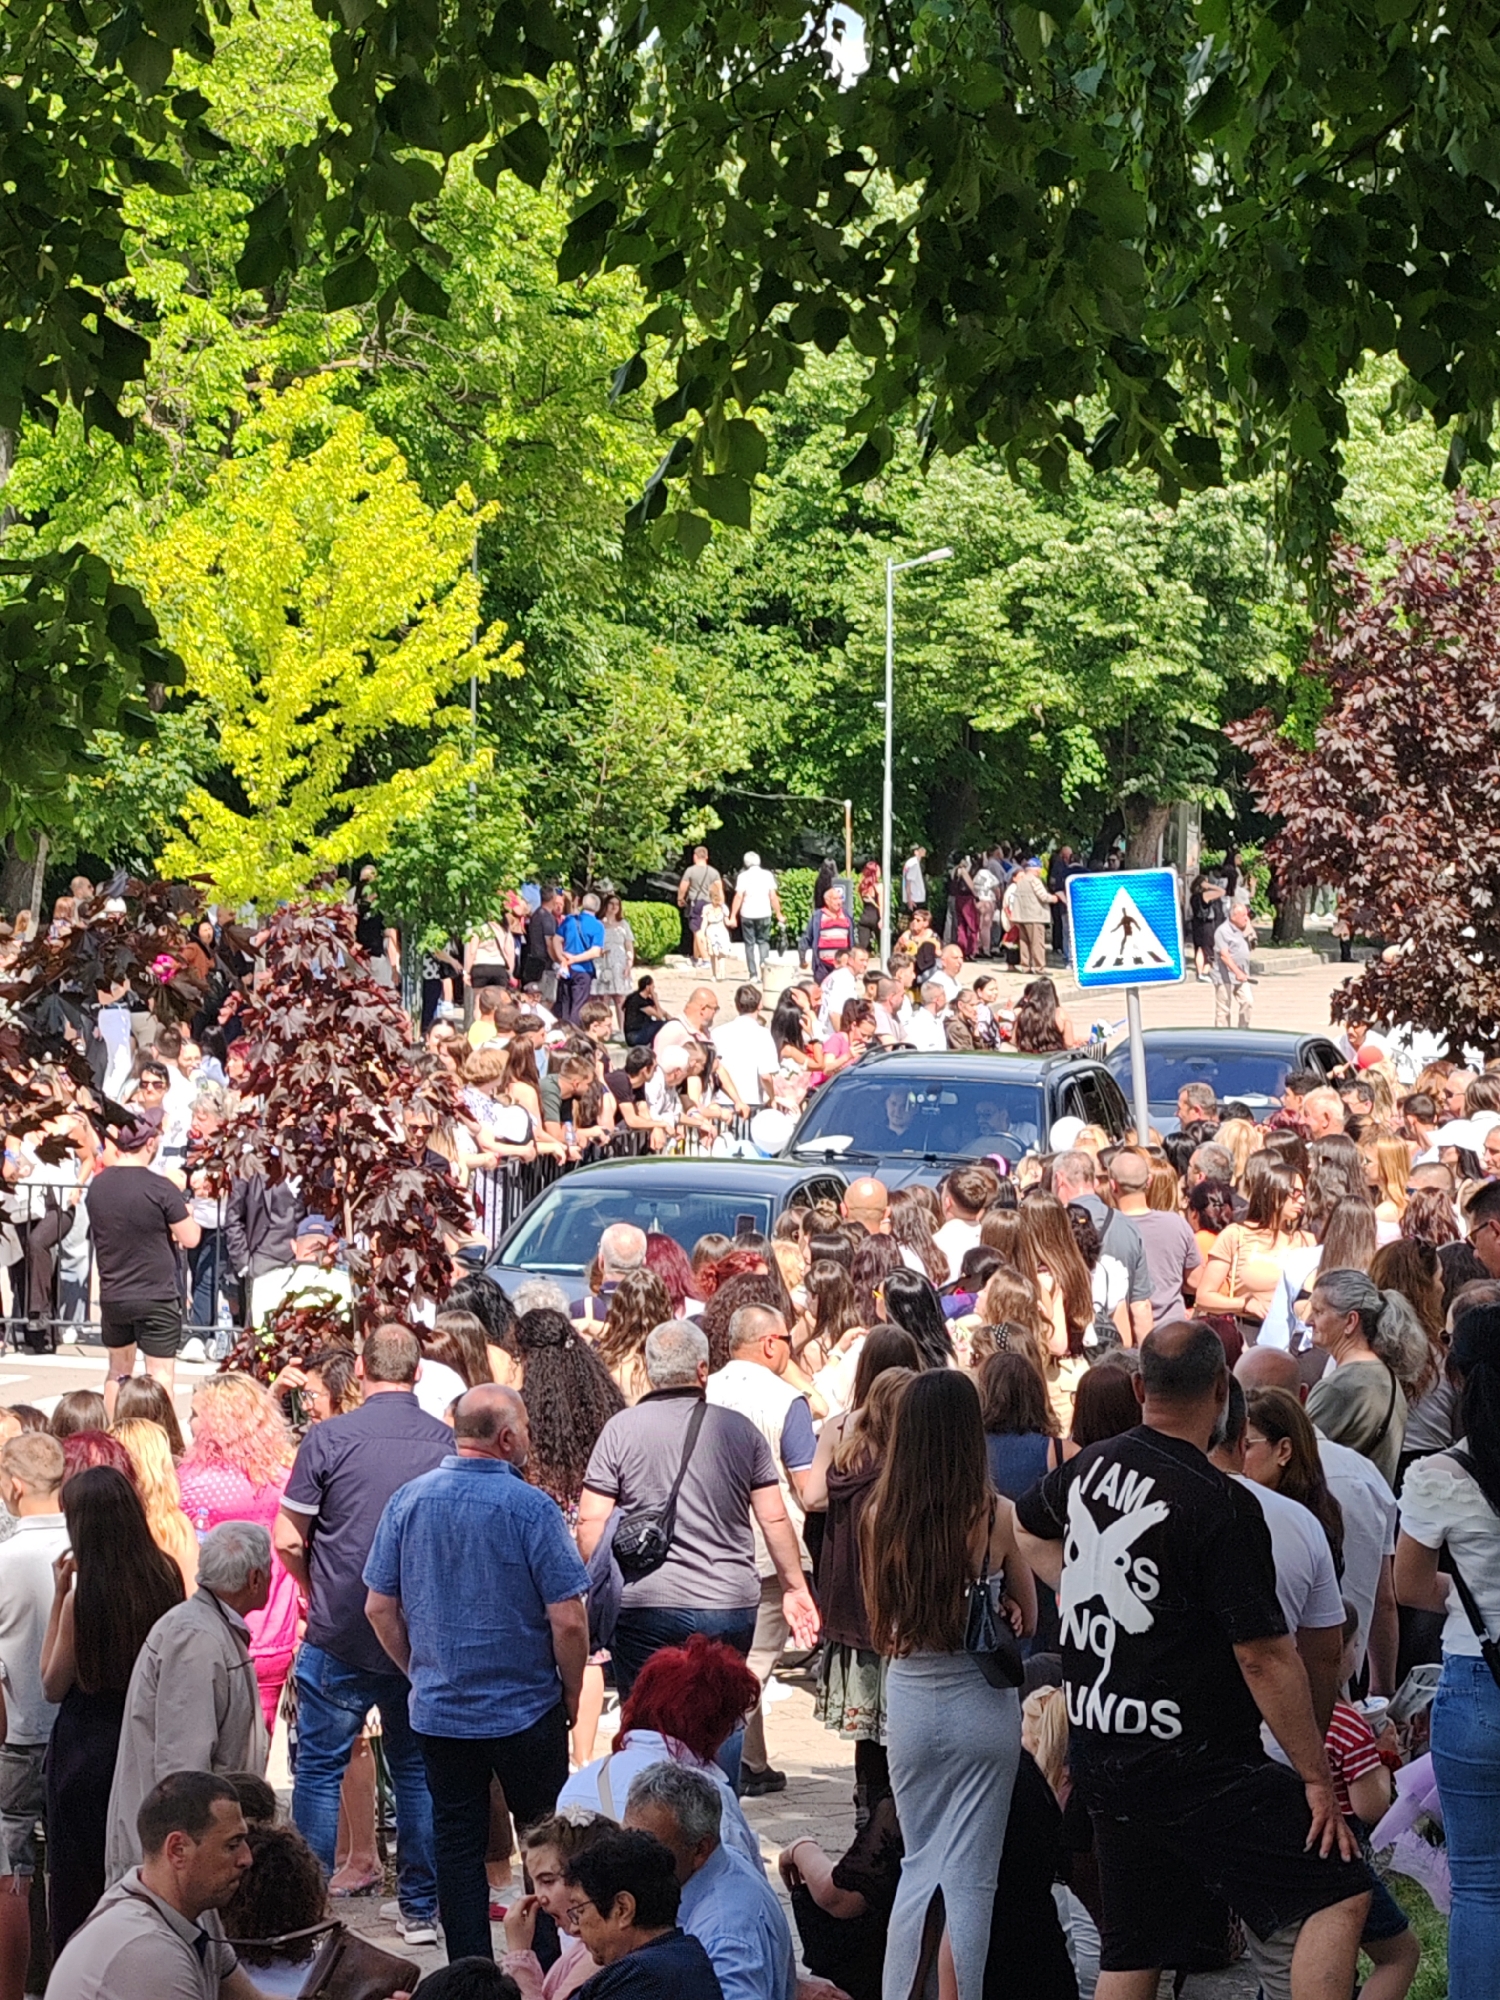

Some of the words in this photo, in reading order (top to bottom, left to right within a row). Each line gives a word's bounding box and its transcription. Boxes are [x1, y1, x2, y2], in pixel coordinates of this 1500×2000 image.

[1080, 1455, 1105, 1495] I
[1091, 1461, 1156, 1515] AM
[1062, 1679, 1183, 1740] UNDS
